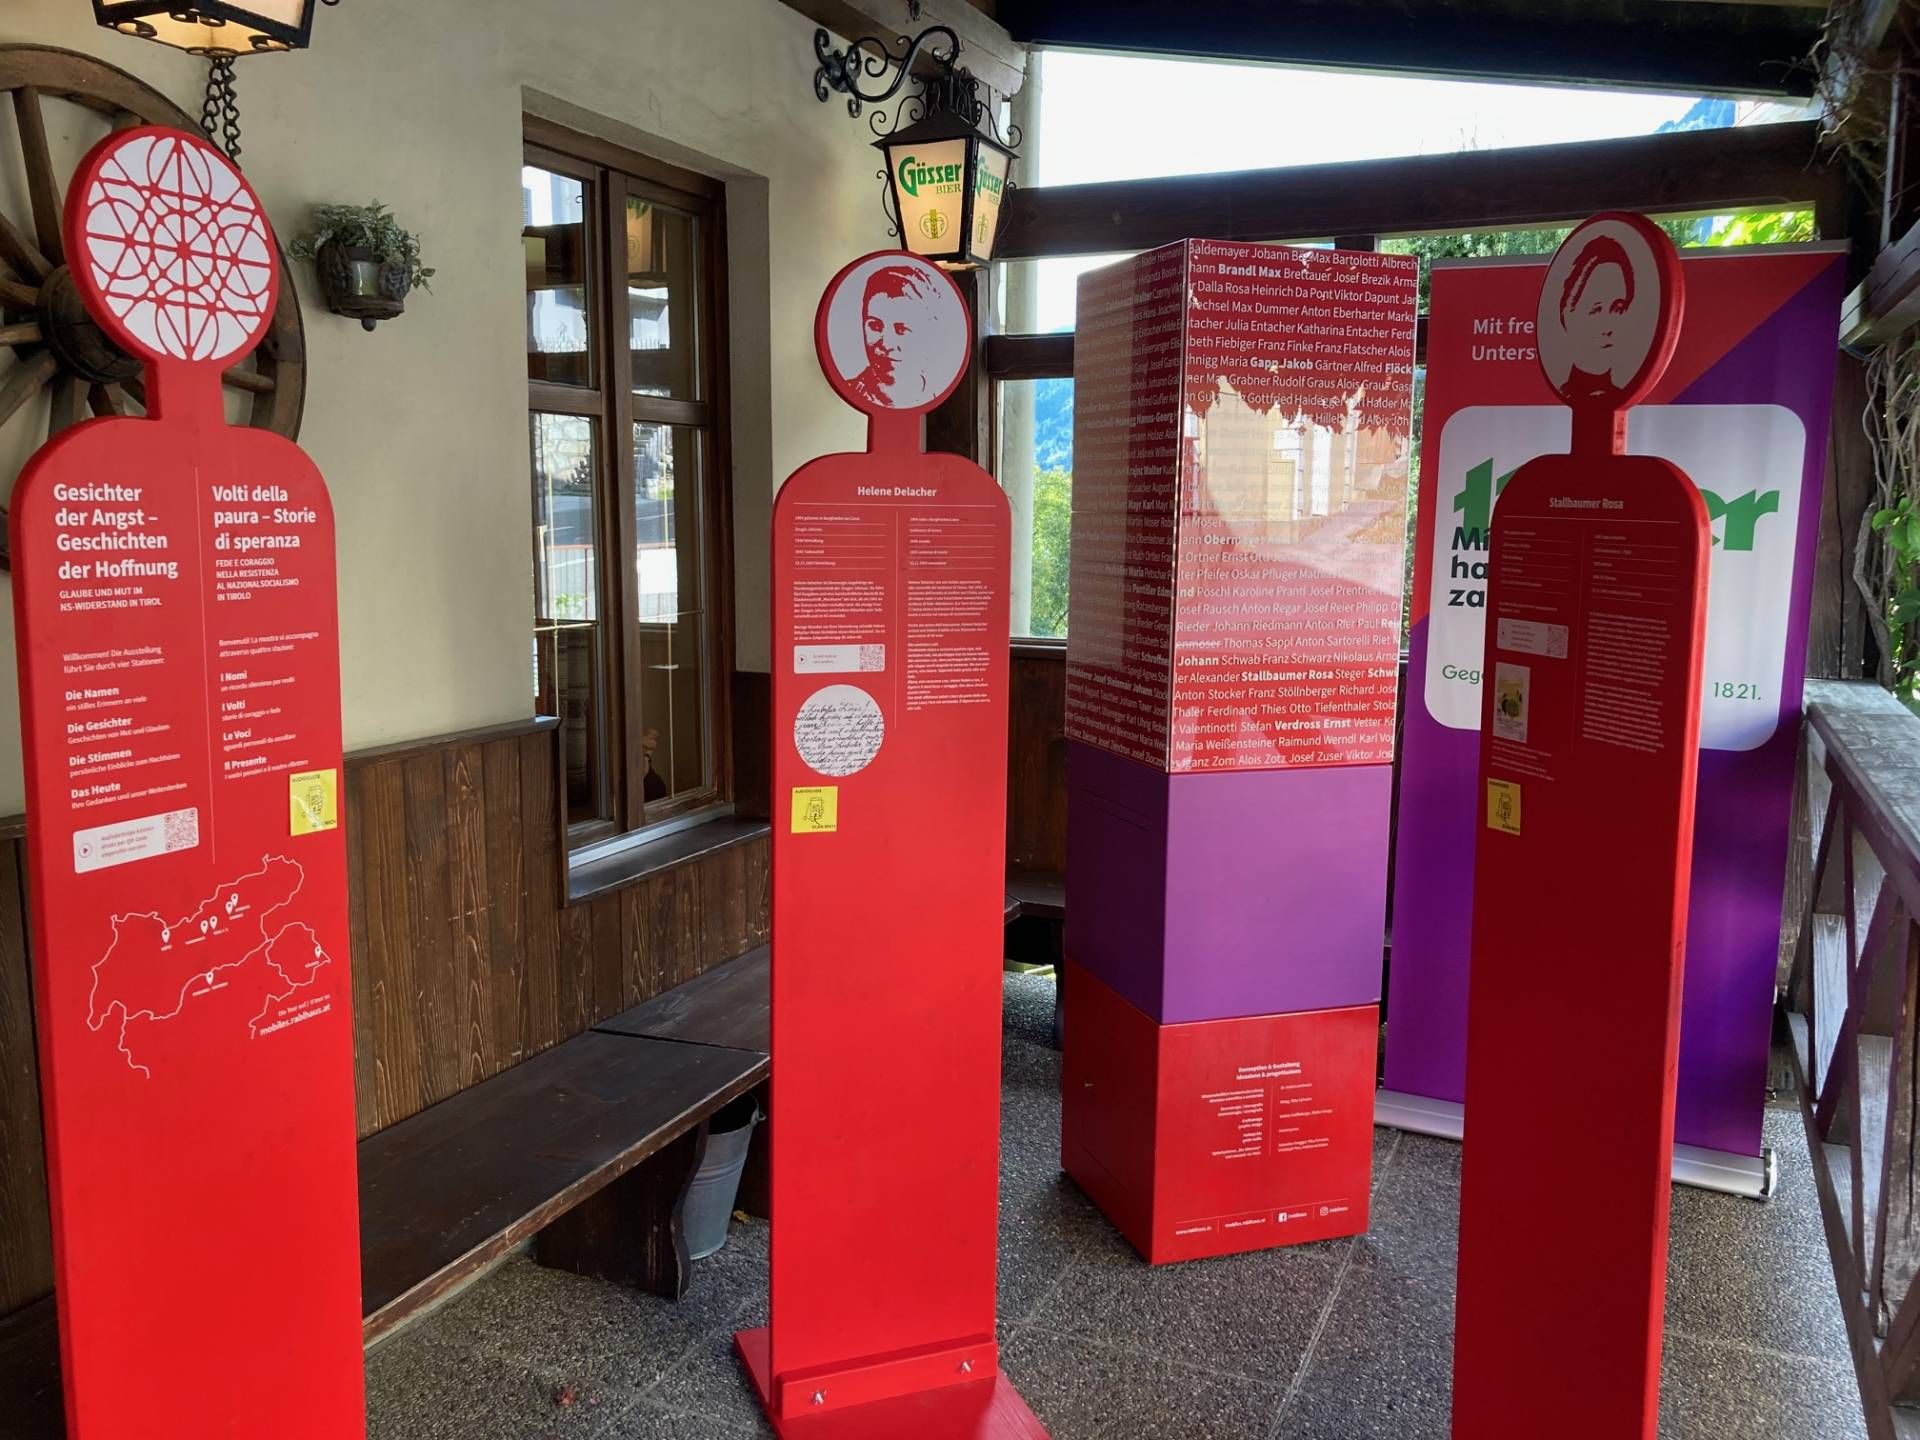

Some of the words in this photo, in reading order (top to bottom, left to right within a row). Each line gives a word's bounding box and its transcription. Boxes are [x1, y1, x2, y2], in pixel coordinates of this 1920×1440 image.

[899, 156, 962, 197] Gösser
[976, 156, 1002, 198] Gösser
[936, 184, 961, 195] BIER
[1252, 248, 1289, 260] Johann
[1333, 253, 1379, 267] Bartolotti
[1219, 264, 1256, 276] Brandl
[1259, 266, 1281, 277] Max
[1284, 268, 1331, 281] Brettauer
[1334, 272, 1360, 282] Josef
[1362, 273, 1390, 285] Brezik
[1198, 281, 1223, 292] Dalla
[1226, 283, 1249, 294] Rosa
[1252, 284, 1293, 296] Heinrich
[1296, 287, 1308, 298] Da
[1334, 289, 1363, 301] Viktor
[1365, 291, 1399, 305] Dapunt
[1232, 302, 1252, 312] Max
[1255, 303, 1299, 315] Dummer
[1301, 305, 1330, 317] Anton
[1333, 307, 1384, 320] Eberharter
[1225, 320, 1248, 331] Julia
[1251, 321, 1295, 333] Entacher
[1298, 323, 1344, 336] Katharina
[1347, 326, 1388, 338] Entacher
[1473, 318, 1503, 334] Mit
[1216, 337, 1256, 351] Fiebiger
[1258, 339, 1285, 351] Franz
[1287, 340, 1313, 352] Finke
[1316, 342, 1341, 353] Franz
[1344, 344, 1387, 356] Flatscher
[1388, 346, 1411, 357] Alois
[1472, 345, 1538, 360] Unters
[1220, 355, 1248, 367] Maria
[1280, 358, 1313, 370] Jakob
[1315, 360, 1352, 371] Gärtner
[1354, 362, 1382, 373] Alfred
[1385, 363, 1412, 373] Flöck
[1229, 374, 1270, 385] Grabner
[1272, 376, 1305, 387] Rudolf
[1307, 377, 1335, 389] Graus
[1337, 379, 1359, 389] Alois
[1248, 392, 1292, 404] Gottfried
[54, 482, 142, 501] Gesichter
[212, 485, 248, 501] Volti
[252, 486, 288, 501] della
[858, 487, 891, 496] Helene
[895, 487, 936, 497] Delacher
[1550, 497, 1600, 509] Stallbaumer
[1603, 499, 1623, 509] Rosa
[55, 508, 88, 526] der
[92, 508, 145, 530] Angst
[214, 511, 258, 528] paura
[274, 507, 316, 523] Storie
[57, 531, 167, 551] Geschichten
[215, 533, 230, 549] di
[234, 535, 300, 552] speranza
[58, 561, 91, 579] der
[96, 559, 178, 579] Hoffnung
[240, 558, 274, 566] CORAGGIO
[239, 569, 279, 577] RESISTENZA
[1231, 569, 1260, 579] Oskar
[227, 579, 299, 589] NAZIONALSOCIALISMO
[1233, 586, 1273, 597] Karoline
[1310, 585, 1334, 596] Josef
[60, 589, 93, 598] GLAUBE
[95, 588, 112, 596] UND
[114, 587, 132, 595] MUT
[227, 592, 251, 600] TIROLO
[61, 601, 127, 611] NS-WIDERSTAND
[130, 599, 138, 607] IN
[139, 598, 162, 606] TIROL
[1203, 604, 1240, 614] Rausch
[1240, 604, 1273, 614] Anton
[1303, 603, 1328, 613] Josef
[1356, 602, 1388, 613] Philipp
[1176, 622, 1209, 632] Rieder
[1213, 621, 1249, 631] Johann
[1252, 620, 1302, 631] Riedmann
[1305, 620, 1335, 629] Anton
[1358, 619, 1378, 628] Paul
[1223, 638, 1263, 648] Thomas
[1266, 636, 1293, 649] Sappl
[1296, 637, 1324, 647] Anton
[1327, 635, 1370, 646] Sartorelli
[1179, 655, 1219, 666] Johann
[1221, 654, 1260, 665] Schwab
[1263, 654, 1289, 664] Franz
[1291, 652, 1332, 663] Schwarz
[1333, 652, 1373, 662] Nikolaus
[221, 673, 224, 682] I
[225, 670, 247, 681] Nomi
[1190, 672, 1240, 683] Alexander
[1242, 670, 1307, 682] Stallbaumer
[1309, 670, 1334, 679] Rosa
[1335, 669, 1365, 681] Steger
[1442, 665, 1483, 684] Geg
[66, 690, 82, 700] Die
[84, 688, 119, 698] Namen
[1174, 691, 1204, 700] Anton
[1208, 688, 1245, 700] Stocker
[1248, 688, 1274, 698] Franz
[1278, 687, 1336, 698] Stöllnberger
[1340, 685, 1374, 695] Richard
[1713, 682, 1761, 700] 1821.
[222, 704, 225, 712] I
[227, 700, 245, 711] Volti
[1174, 706, 1204, 717] Thaler
[1207, 705, 1257, 716] Ferdinand
[1261, 704, 1287, 714] Thies
[1290, 704, 1311, 713] Otto
[1315, 702, 1370, 712] Tiefenthaler
[68, 724, 84, 733] Die
[86, 718, 132, 731] Gesichter
[1180, 722, 1237, 734] Valentinotti
[1240, 721, 1272, 731] Stefan
[1274, 720, 1320, 730] Verdross
[1324, 718, 1351, 729] Ernst
[1354, 717, 1381, 727] Vetter
[223, 732, 233, 741] Le
[234, 728, 251, 739] Voci
[1176, 741, 1203, 751] Maria
[1206, 738, 1275, 750] Weißensteiner
[1279, 736, 1320, 747] Raimund
[1324, 734, 1356, 745] Werndl
[1360, 733, 1377, 743] Karl
[70, 756, 86, 766] Die
[88, 750, 132, 763] Stimmen
[225, 761, 230, 770] Il
[232, 757, 267, 769] Presente
[1239, 755, 1260, 765] Alois
[1263, 754, 1286, 764] Zotz
[1289, 752, 1315, 763] Josef
[1317, 752, 1343, 762] Zuser
[1346, 750, 1374, 760] Viktor
[71, 788, 90, 798] Das
[92, 783, 120, 795] Heute
